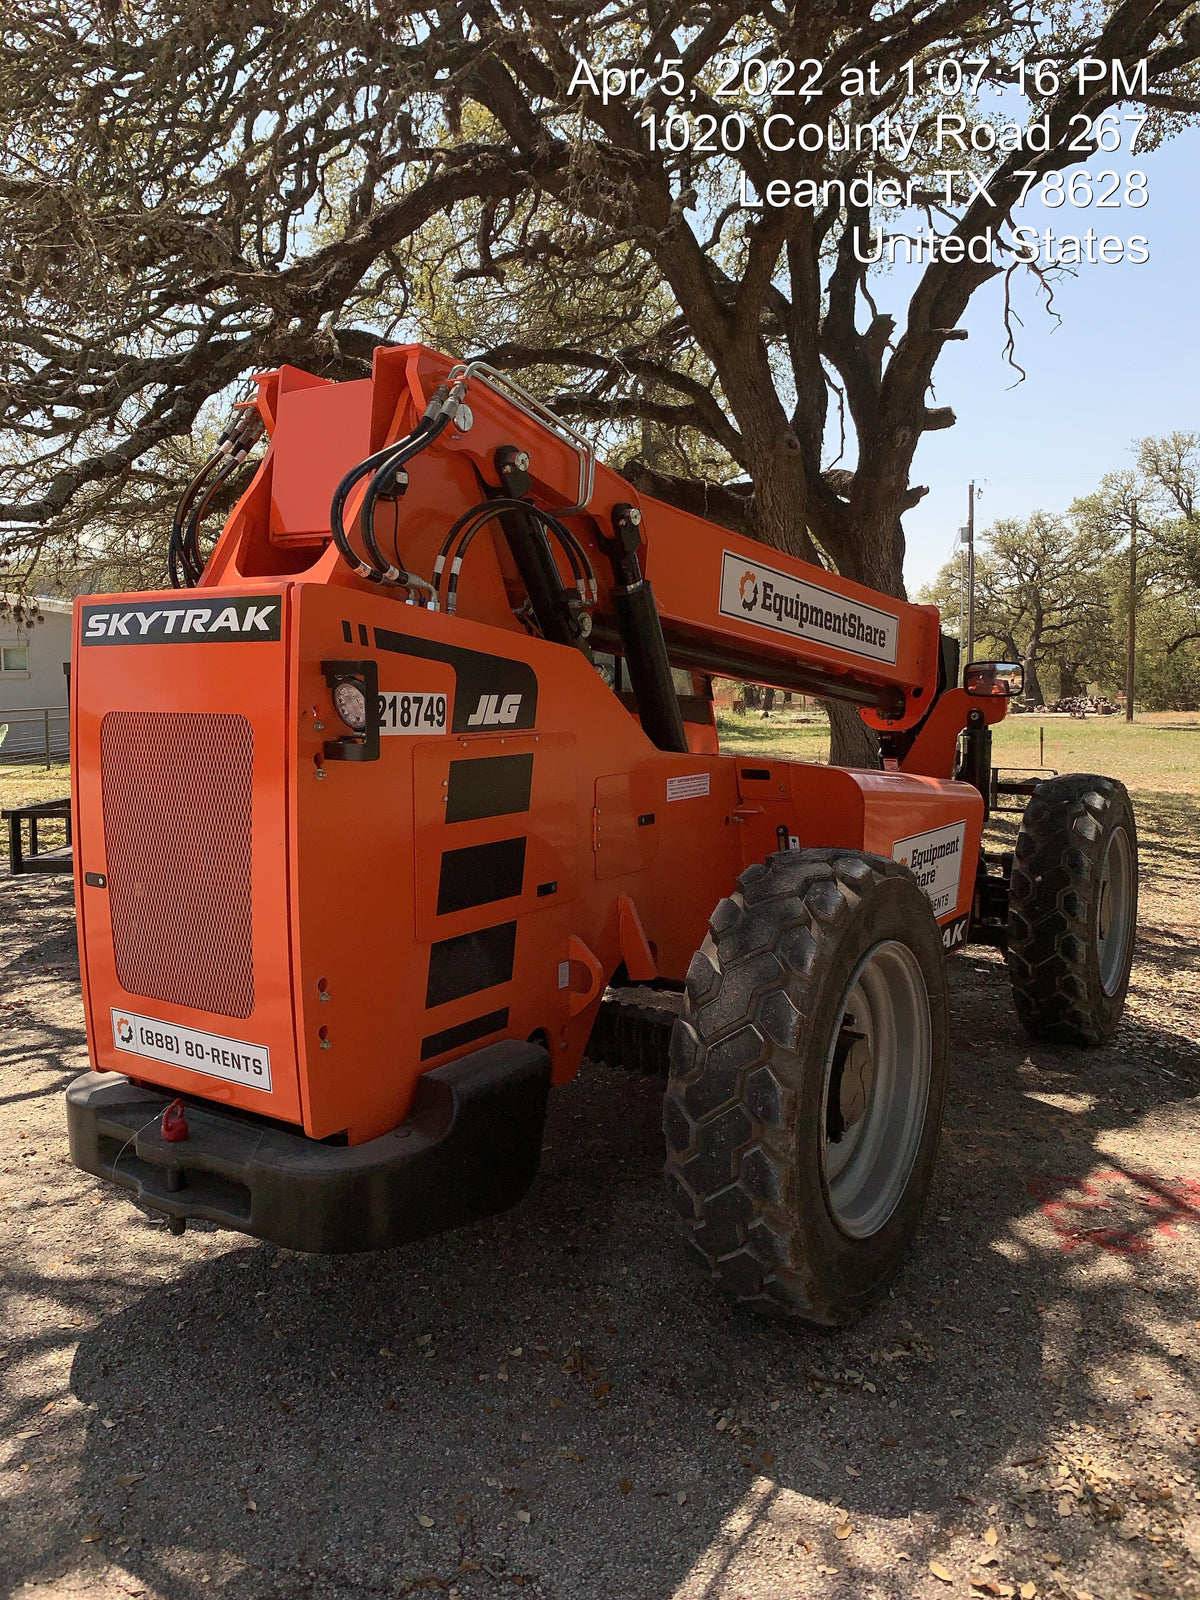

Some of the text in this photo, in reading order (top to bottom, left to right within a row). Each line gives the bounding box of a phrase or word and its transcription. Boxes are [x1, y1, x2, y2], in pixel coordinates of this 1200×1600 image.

[84, 604, 278, 638] SKYTRAK
[760, 581, 886, 649] EquipmentShare
[377, 695, 446, 728] 218749
[467, 694, 523, 726] JLG
[911, 836, 959, 870] Equipment
[915, 869, 936, 888] hare
[931, 893, 949, 911] ENTS
[942, 919, 967, 948] AK
[139, 1026, 263, 1076] (888) 80-RENTS
